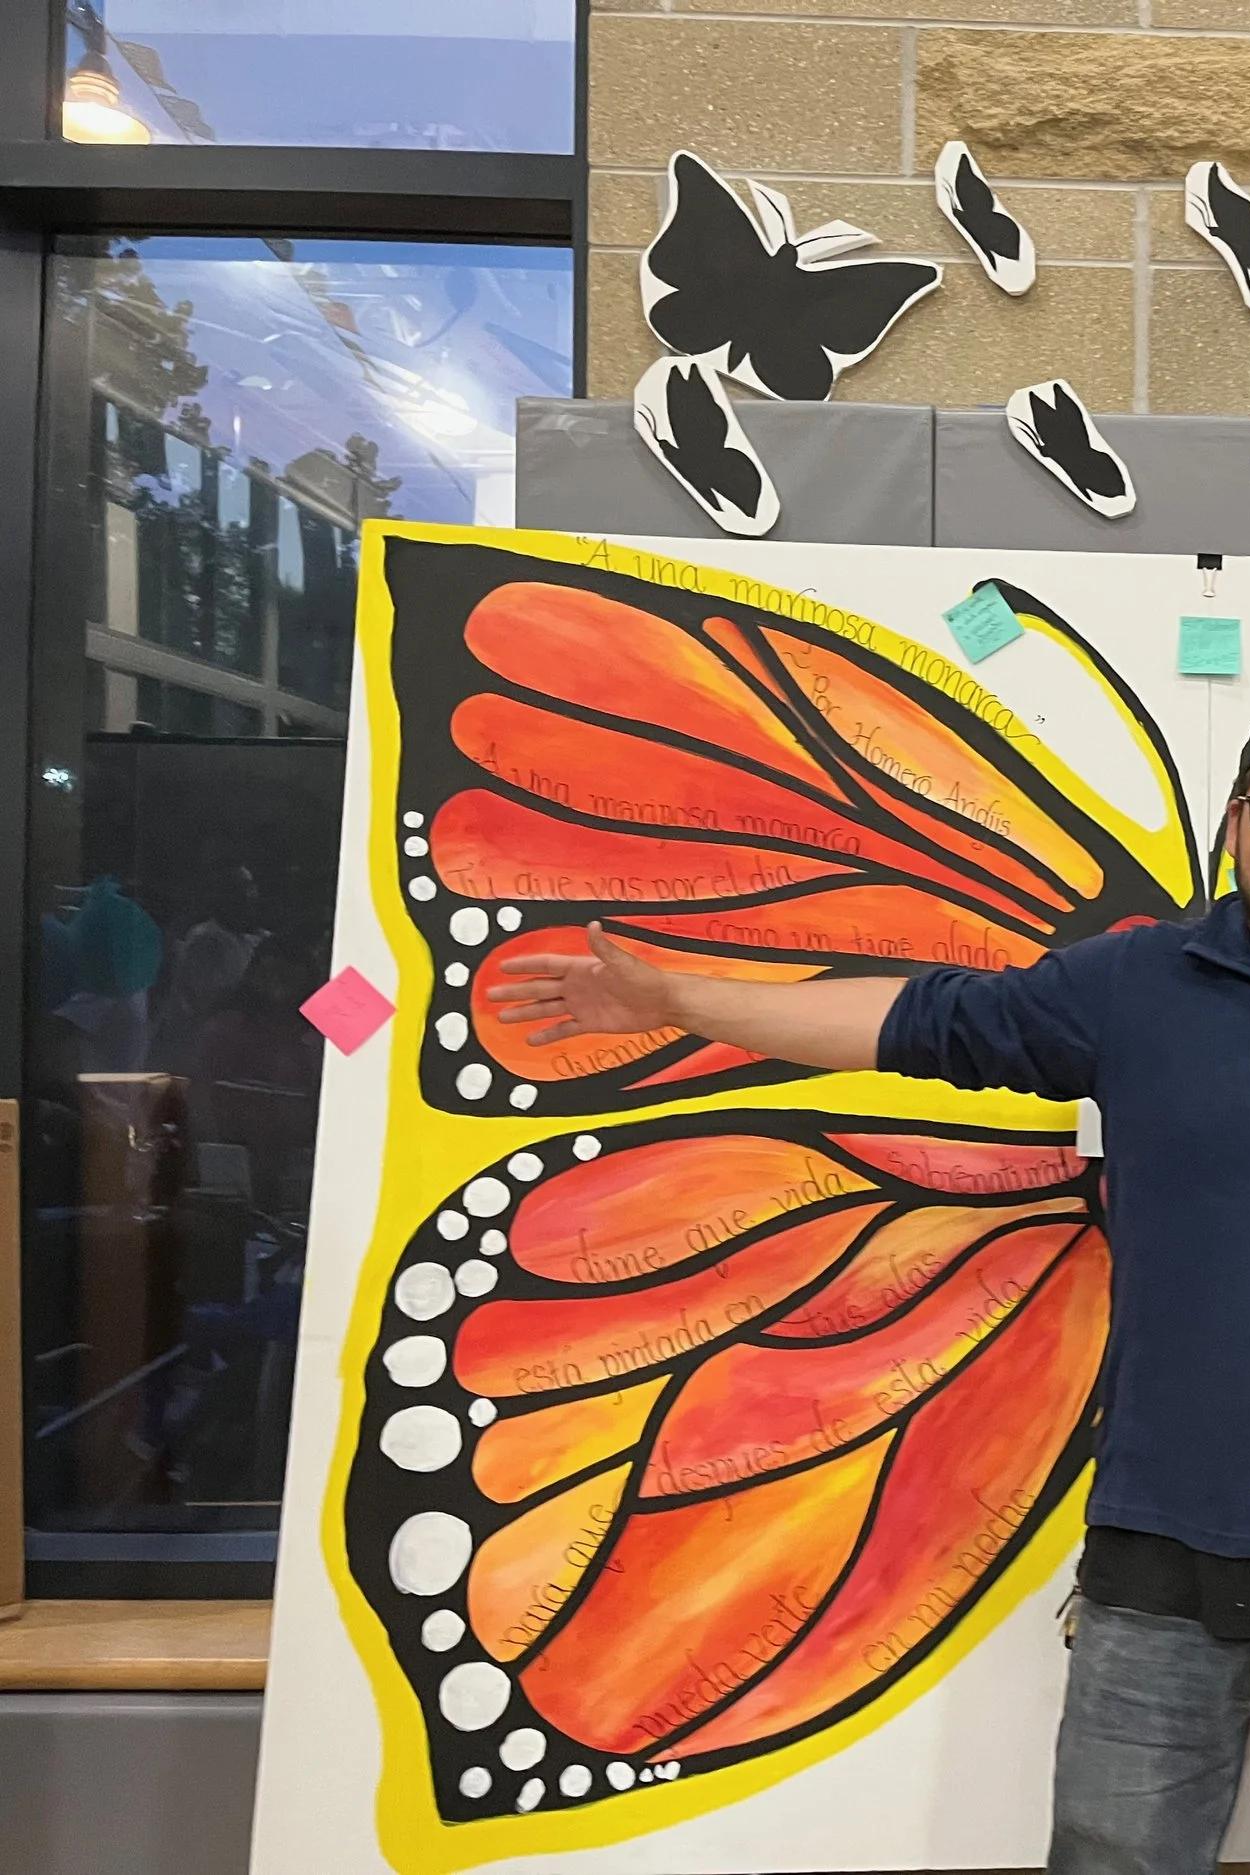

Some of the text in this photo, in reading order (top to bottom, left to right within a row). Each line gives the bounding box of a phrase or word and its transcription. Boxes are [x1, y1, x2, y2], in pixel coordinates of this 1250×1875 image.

[633, 554, 707, 594] una
[729, 578, 877, 652] mariposa
[851, 722, 933, 797] Homero
[511, 768, 572, 806] una
[588, 794, 722, 846] mariposa
[736, 814, 862, 856] monarca
[515, 872, 573, 901] que
[585, 877, 645, 900] vas
[710, 860, 742, 898] el
[706, 920, 779, 949] como
[791, 930, 833, 951] un
[931, 920, 1011, 972] alado
[551, 1026, 684, 1078] queman
[570, 1156, 850, 1284] dime que vida
[780, 1252, 943, 1337] tus alas
[600, 1308, 716, 1403] pintada
[724, 1295, 767, 1326] en
[810, 1399, 852, 1454] de
[873, 1358, 947, 1417] esta
[956, 1269, 1030, 1342] vida
[499, 1504, 624, 1669] para que
[862, 1488, 1037, 1673] en mi noche
[632, 1586, 822, 1752] pueda verte
